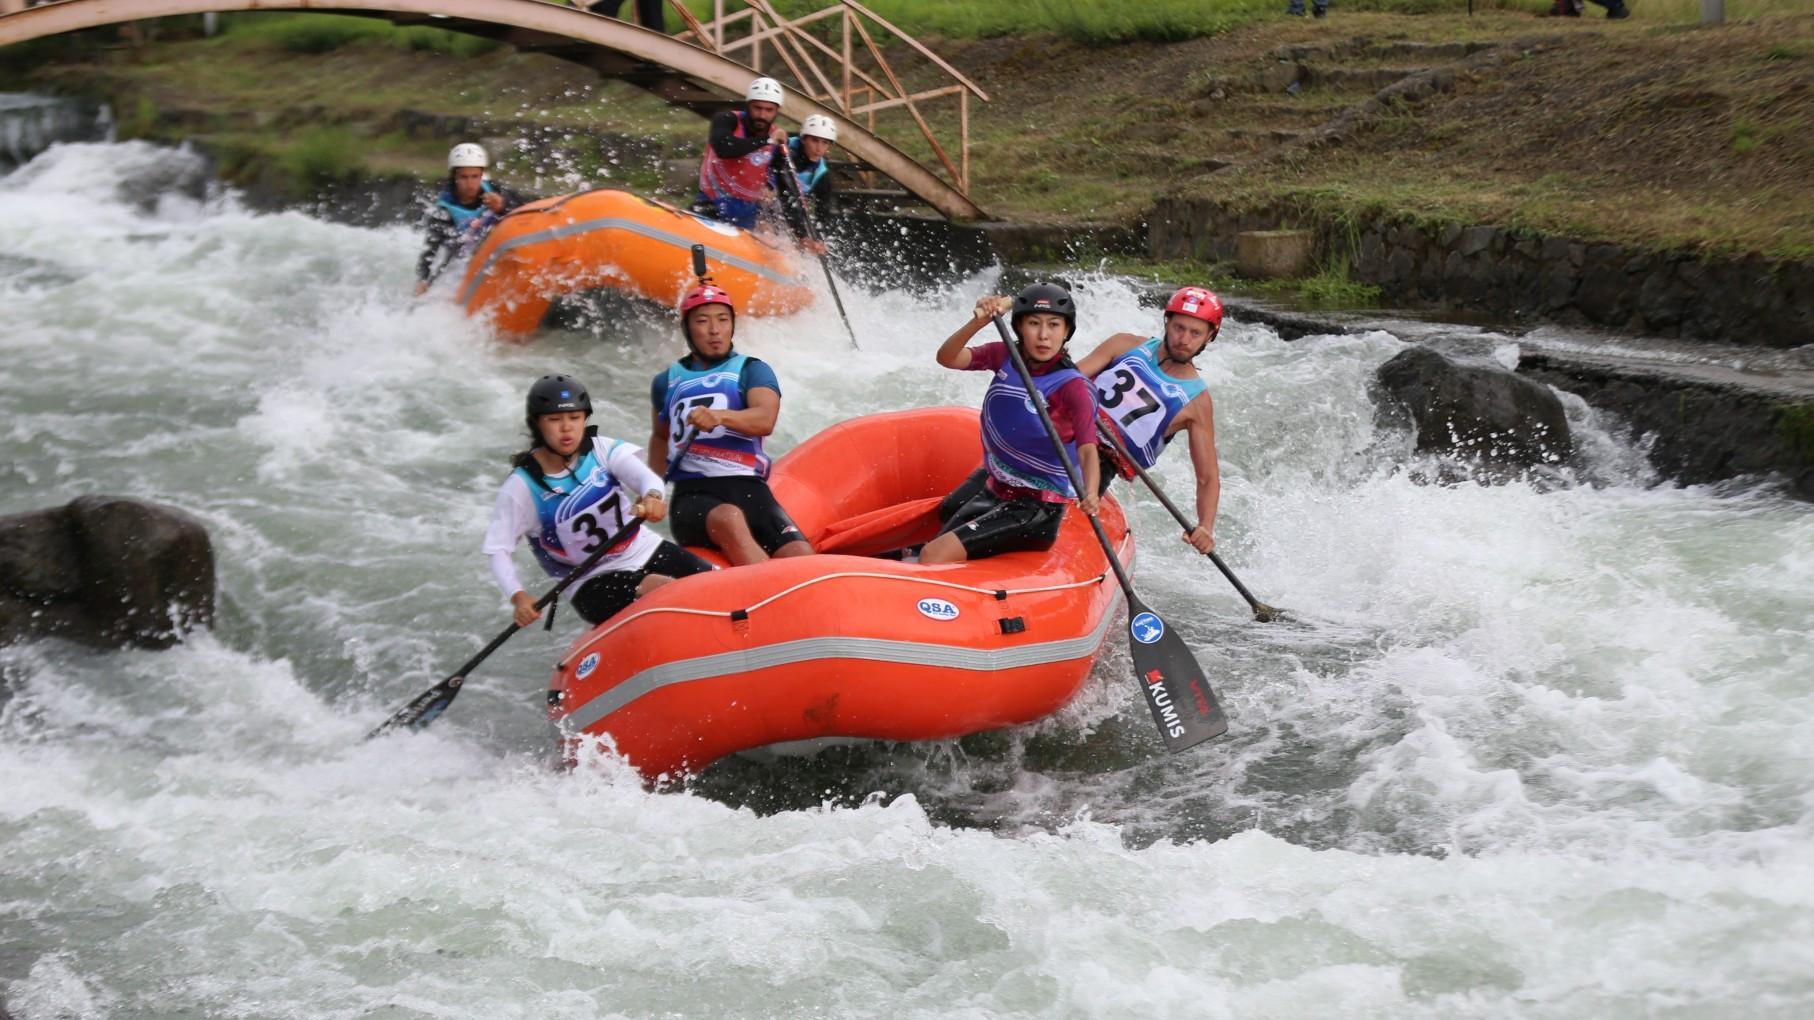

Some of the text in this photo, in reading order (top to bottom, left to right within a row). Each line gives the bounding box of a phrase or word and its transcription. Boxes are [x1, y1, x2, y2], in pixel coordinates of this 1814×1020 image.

[1098, 369, 1161, 428] 37
[571, 491, 625, 554] 37
[919, 601, 957, 615] QSA
[1148, 681, 1185, 738] KUMIS
